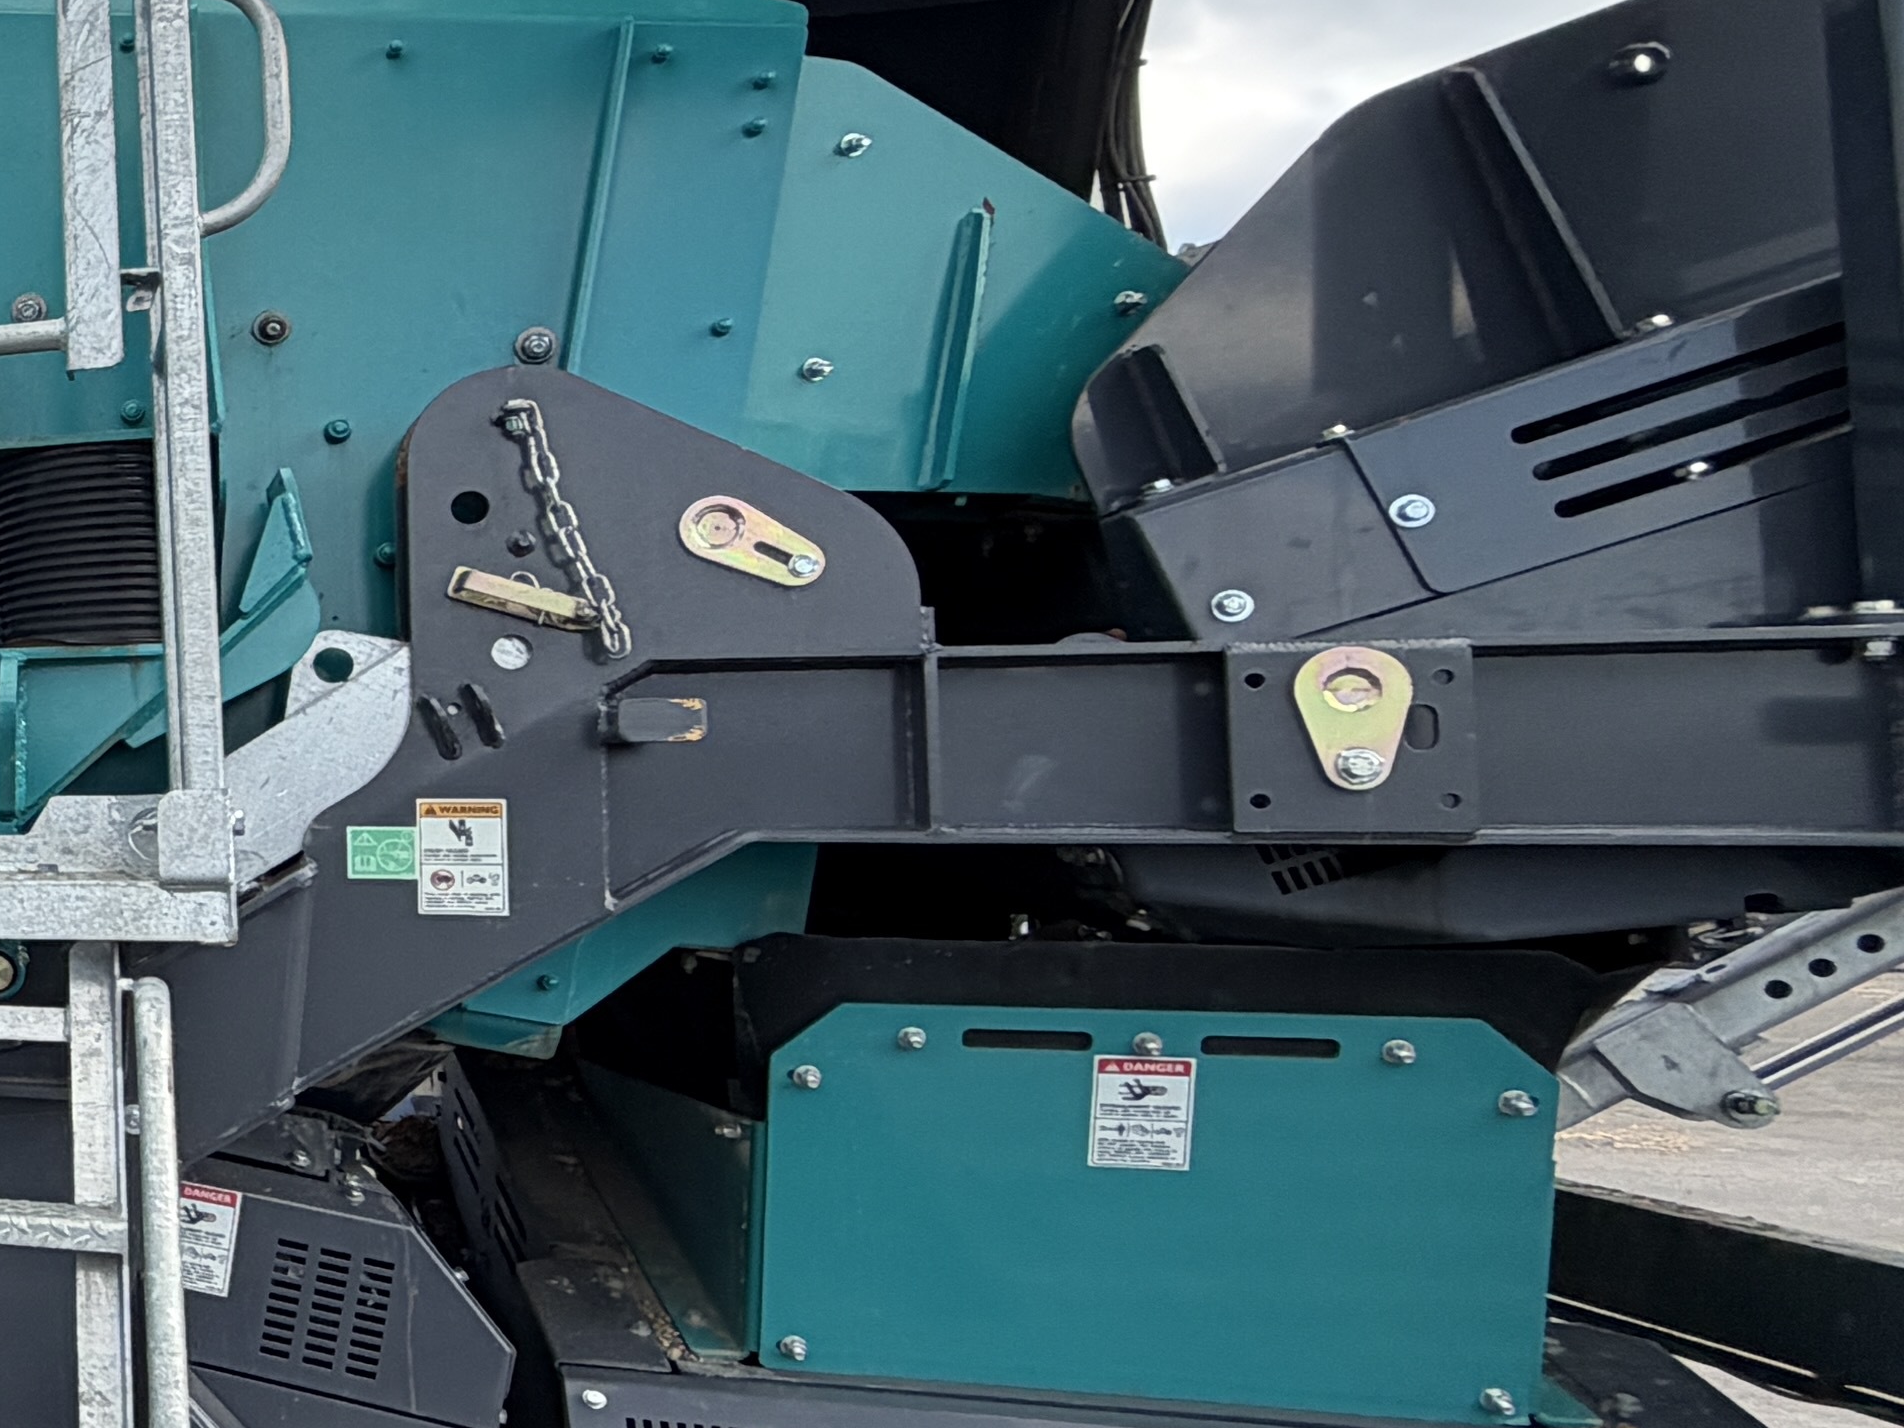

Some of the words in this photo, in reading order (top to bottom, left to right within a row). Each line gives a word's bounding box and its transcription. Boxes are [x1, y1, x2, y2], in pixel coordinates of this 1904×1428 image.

[438, 805, 499, 816] WARNING
[1123, 1061, 1185, 1073] DANGER
[184, 1187, 232, 1203] DANGER
